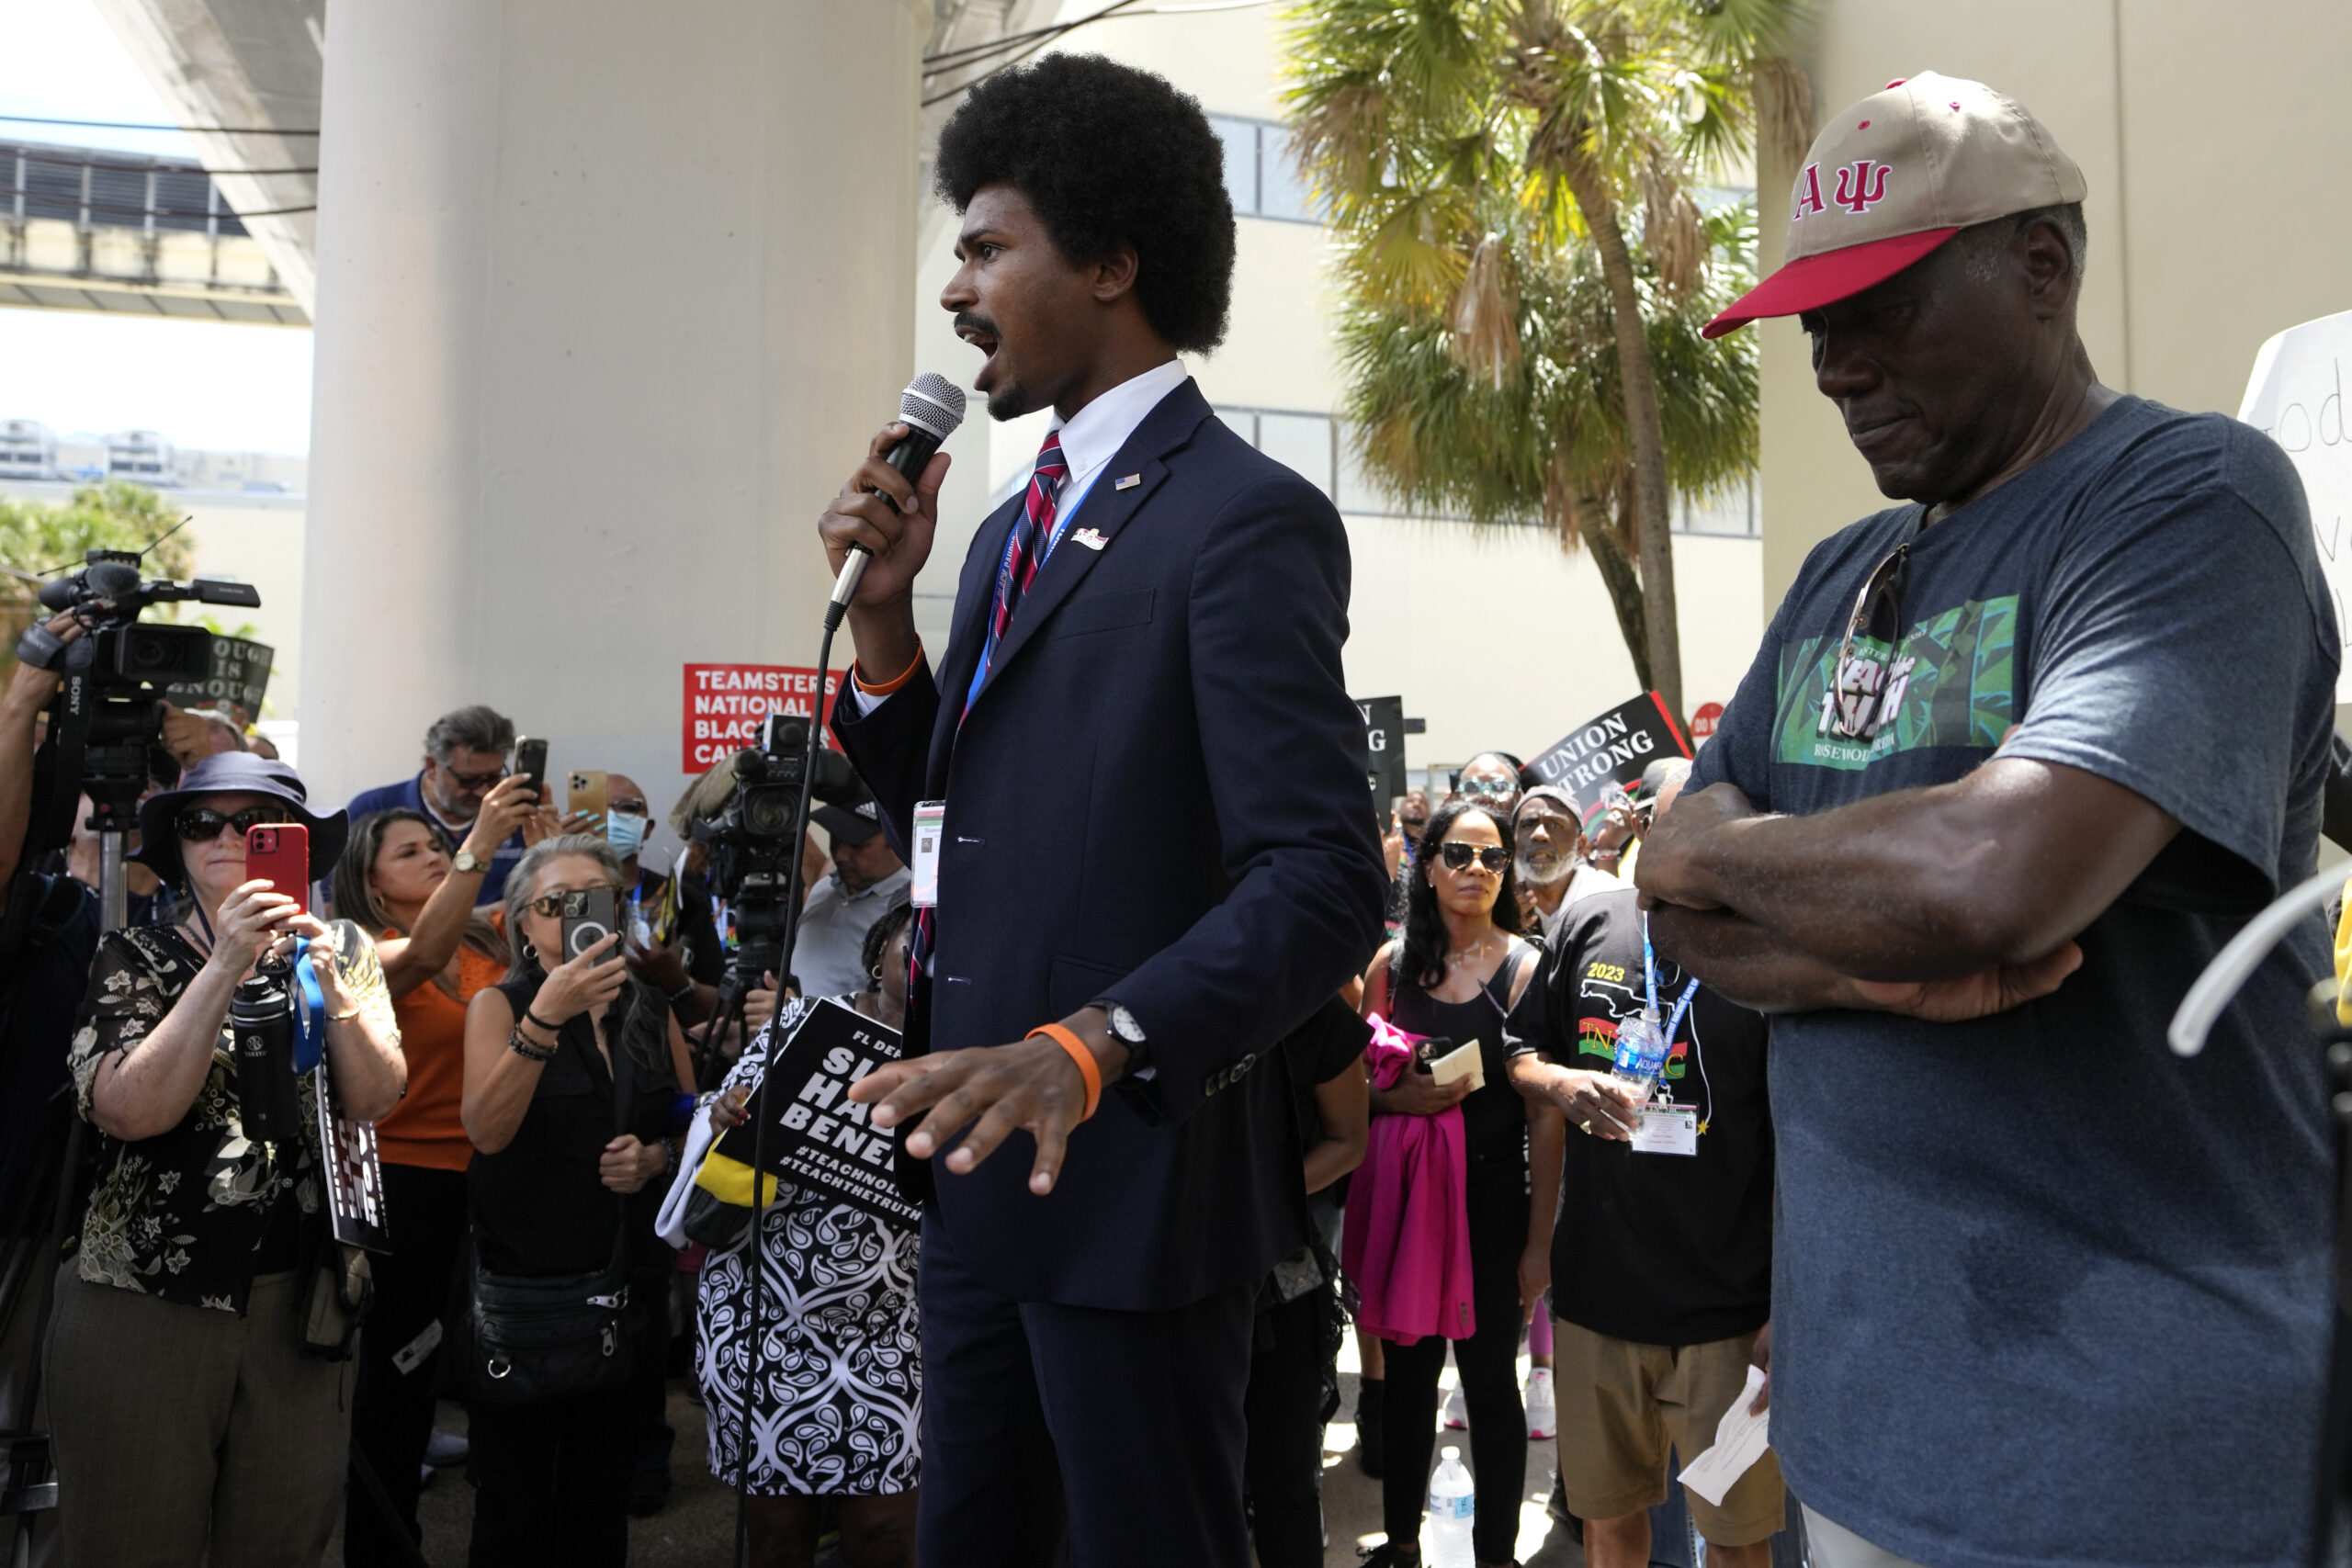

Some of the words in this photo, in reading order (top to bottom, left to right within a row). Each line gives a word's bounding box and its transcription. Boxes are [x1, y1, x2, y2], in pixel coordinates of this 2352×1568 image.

[1791, 160, 1893, 221] AΨ
[212, 638, 272, 667] OUGH
[70, 675, 82, 716] SONY
[695, 671, 837, 695] TEAMSTERS
[695, 695, 811, 716] NATIONAL
[695, 719, 764, 739] BLAC
[1539, 712, 1628, 780] UNION
[1556, 729, 1655, 796] TRONG
[1587, 962, 1625, 982] 2023
[852, 1030, 870, 1045] FL
[873, 1040, 902, 1059] DEP
[1665, 1053, 1684, 1077] C
[795, 1145, 900, 1198] #TEACHNOL
[779, 1156, 922, 1222] #TEACHTHETRUTH
